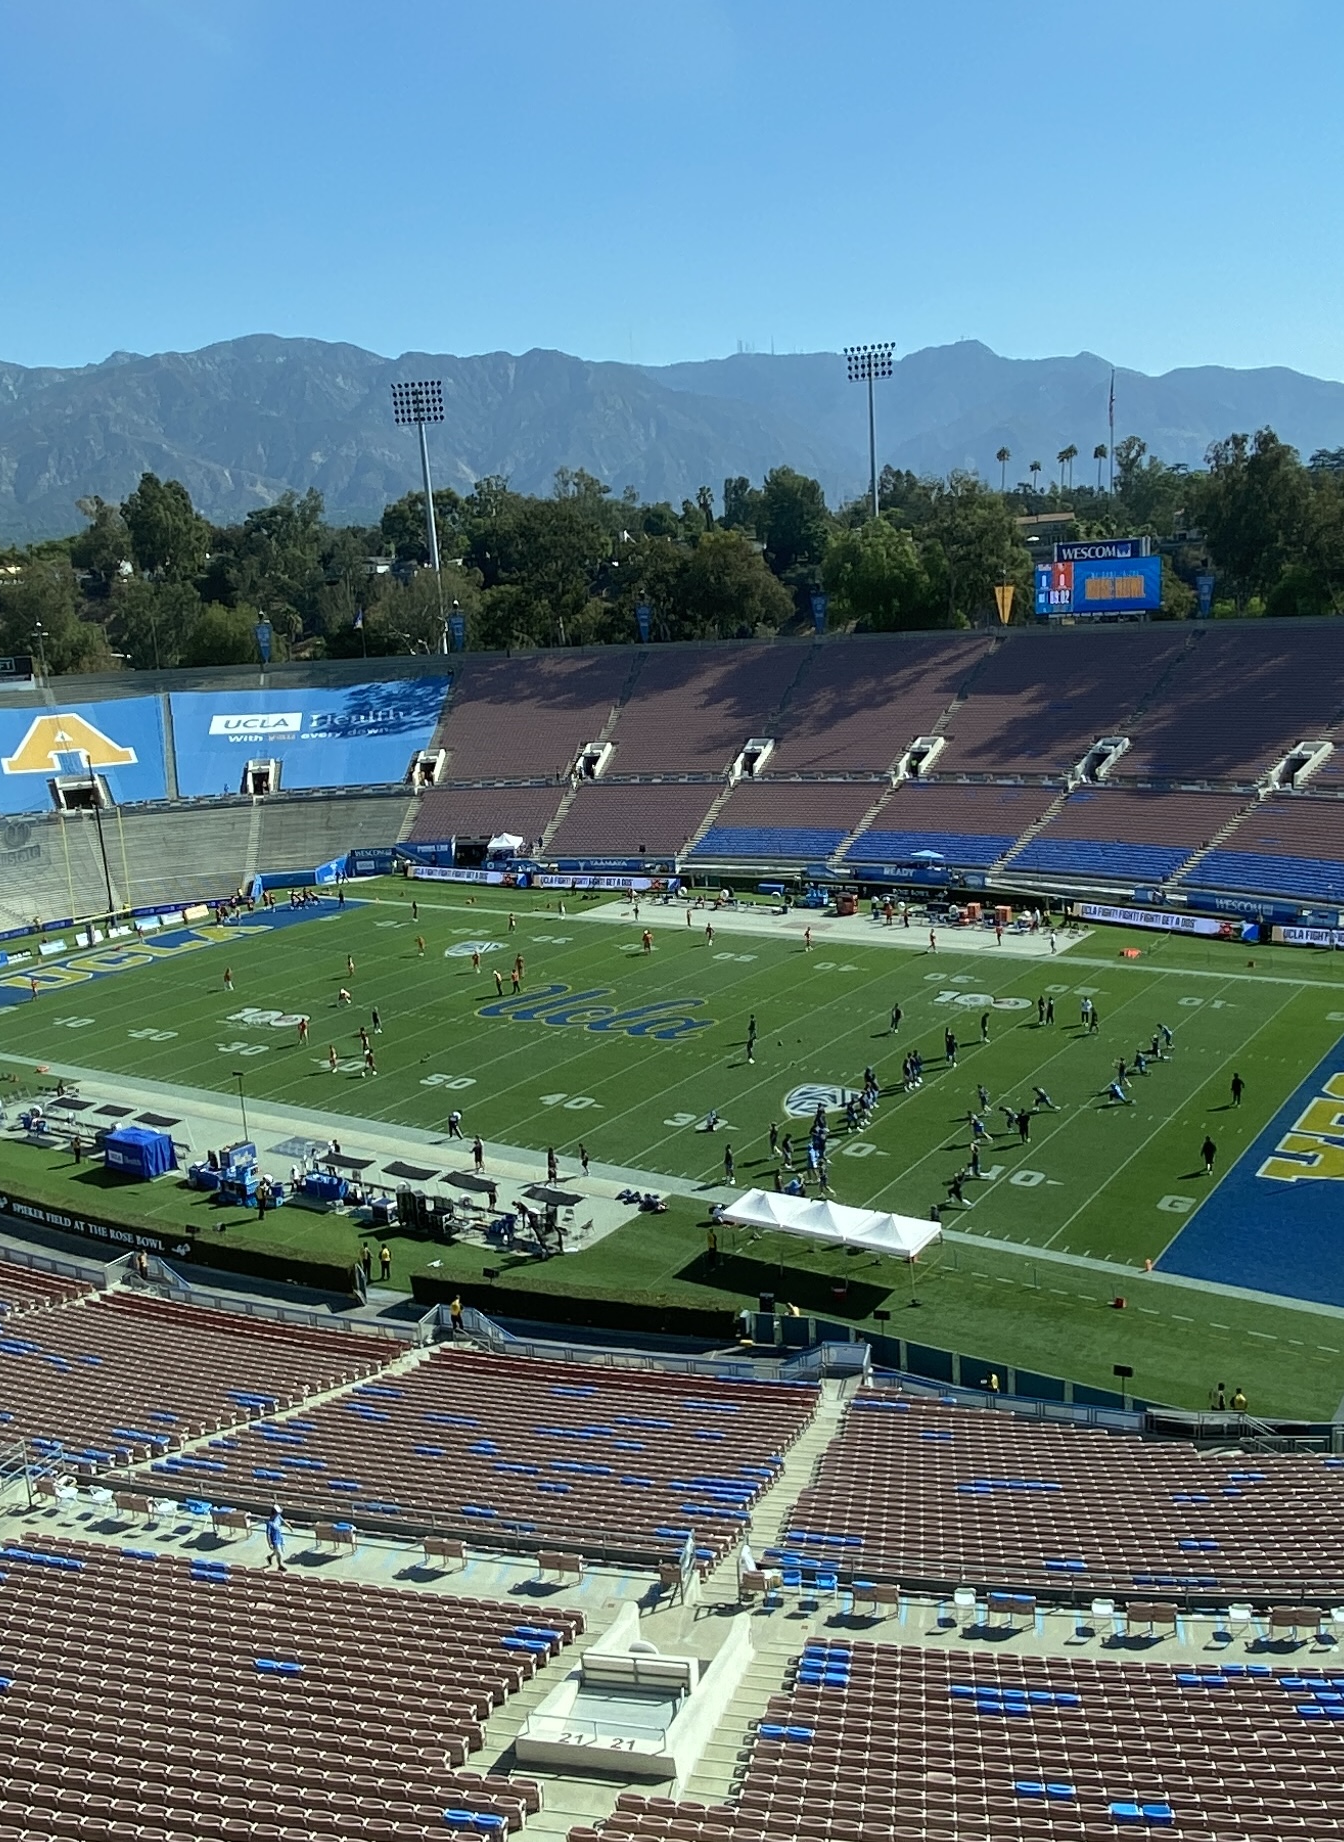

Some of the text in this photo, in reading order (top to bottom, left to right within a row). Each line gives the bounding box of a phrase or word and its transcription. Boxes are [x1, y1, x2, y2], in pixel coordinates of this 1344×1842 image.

[1062, 545, 1116, 560] WESCOM
[223, 709, 406, 730] UCLA Health
[228, 734, 264, 743] With
[884, 867, 916, 877] READY
[1283, 928, 1304, 940] UCLA
[1305, 929, 1330, 942] FIGHT
[474, 983, 719, 1042] Ucla
[419, 1073, 477, 1090] 50
[539, 1093, 596, 1110] 40
[1156, 1194, 1197, 1213] G
[12, 1202, 165, 1251] SPIEKER FIELD AT THE ROSE BOWL
[558, 1732, 584, 1744] 21
[610, 1738, 636, 1751] 21
